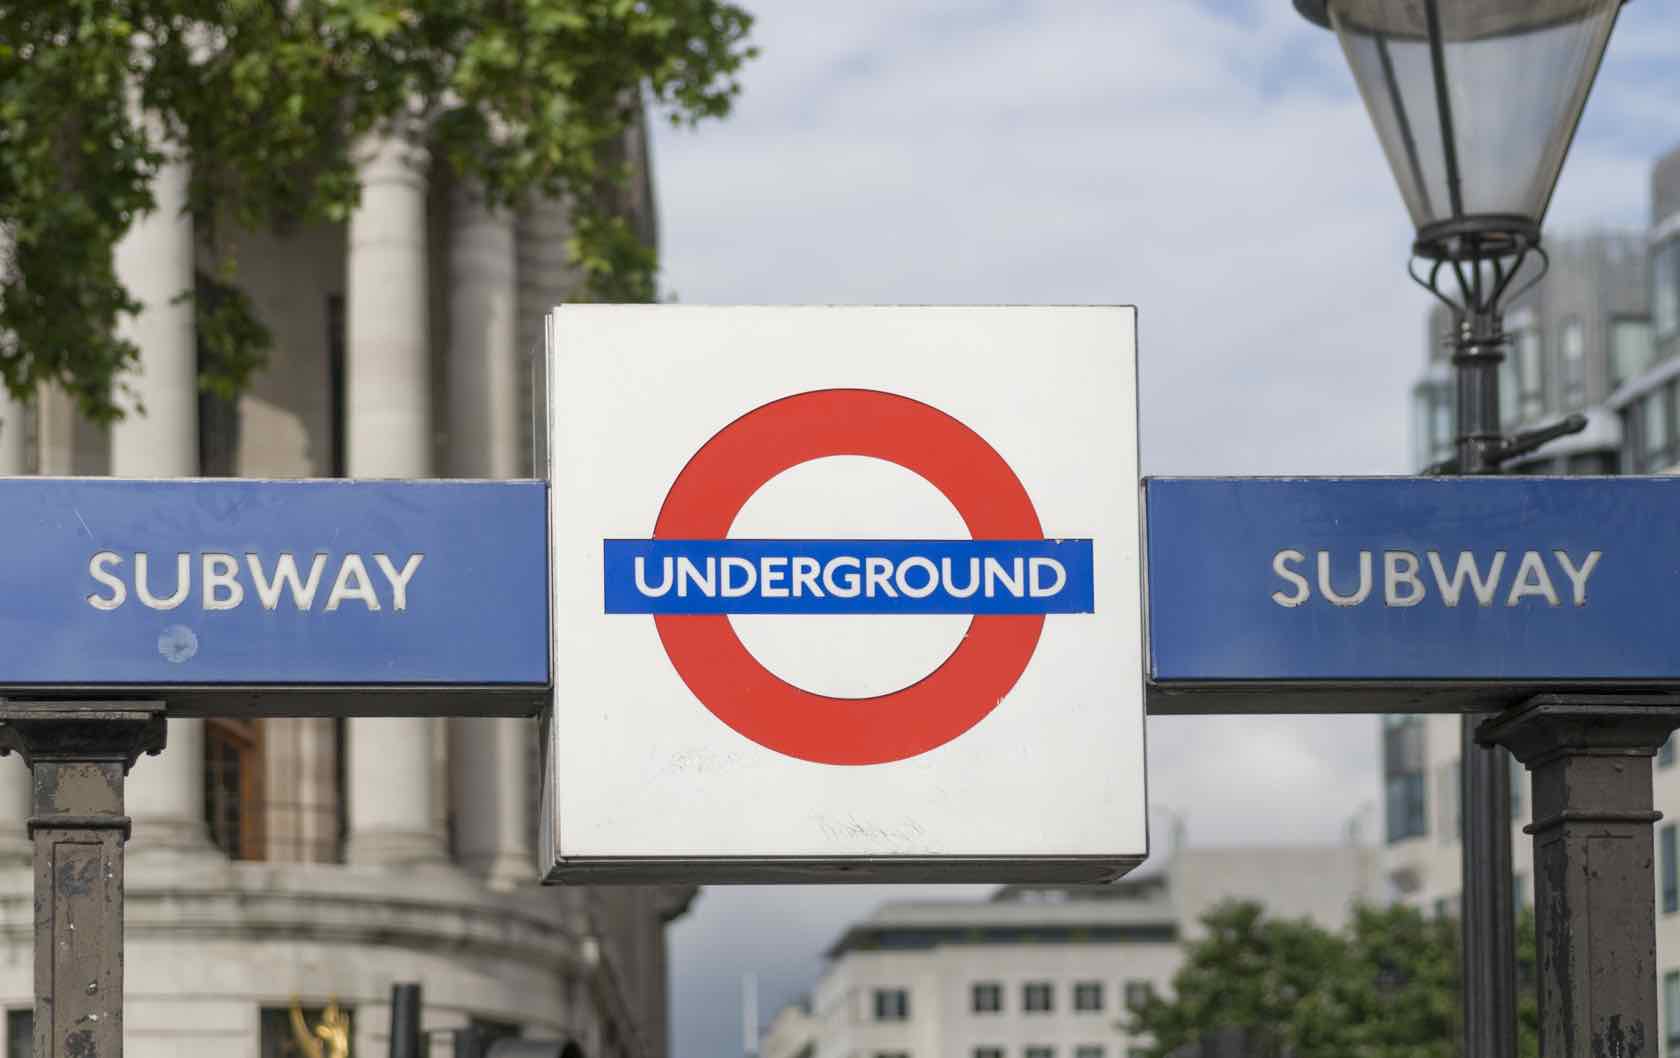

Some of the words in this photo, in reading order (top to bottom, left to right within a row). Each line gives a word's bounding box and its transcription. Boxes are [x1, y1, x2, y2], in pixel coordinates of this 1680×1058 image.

[87, 551, 424, 610] SUBWAY
[634, 556, 1066, 598] UNDERGROUND
[1271, 548, 1600, 608] SUBWAY
